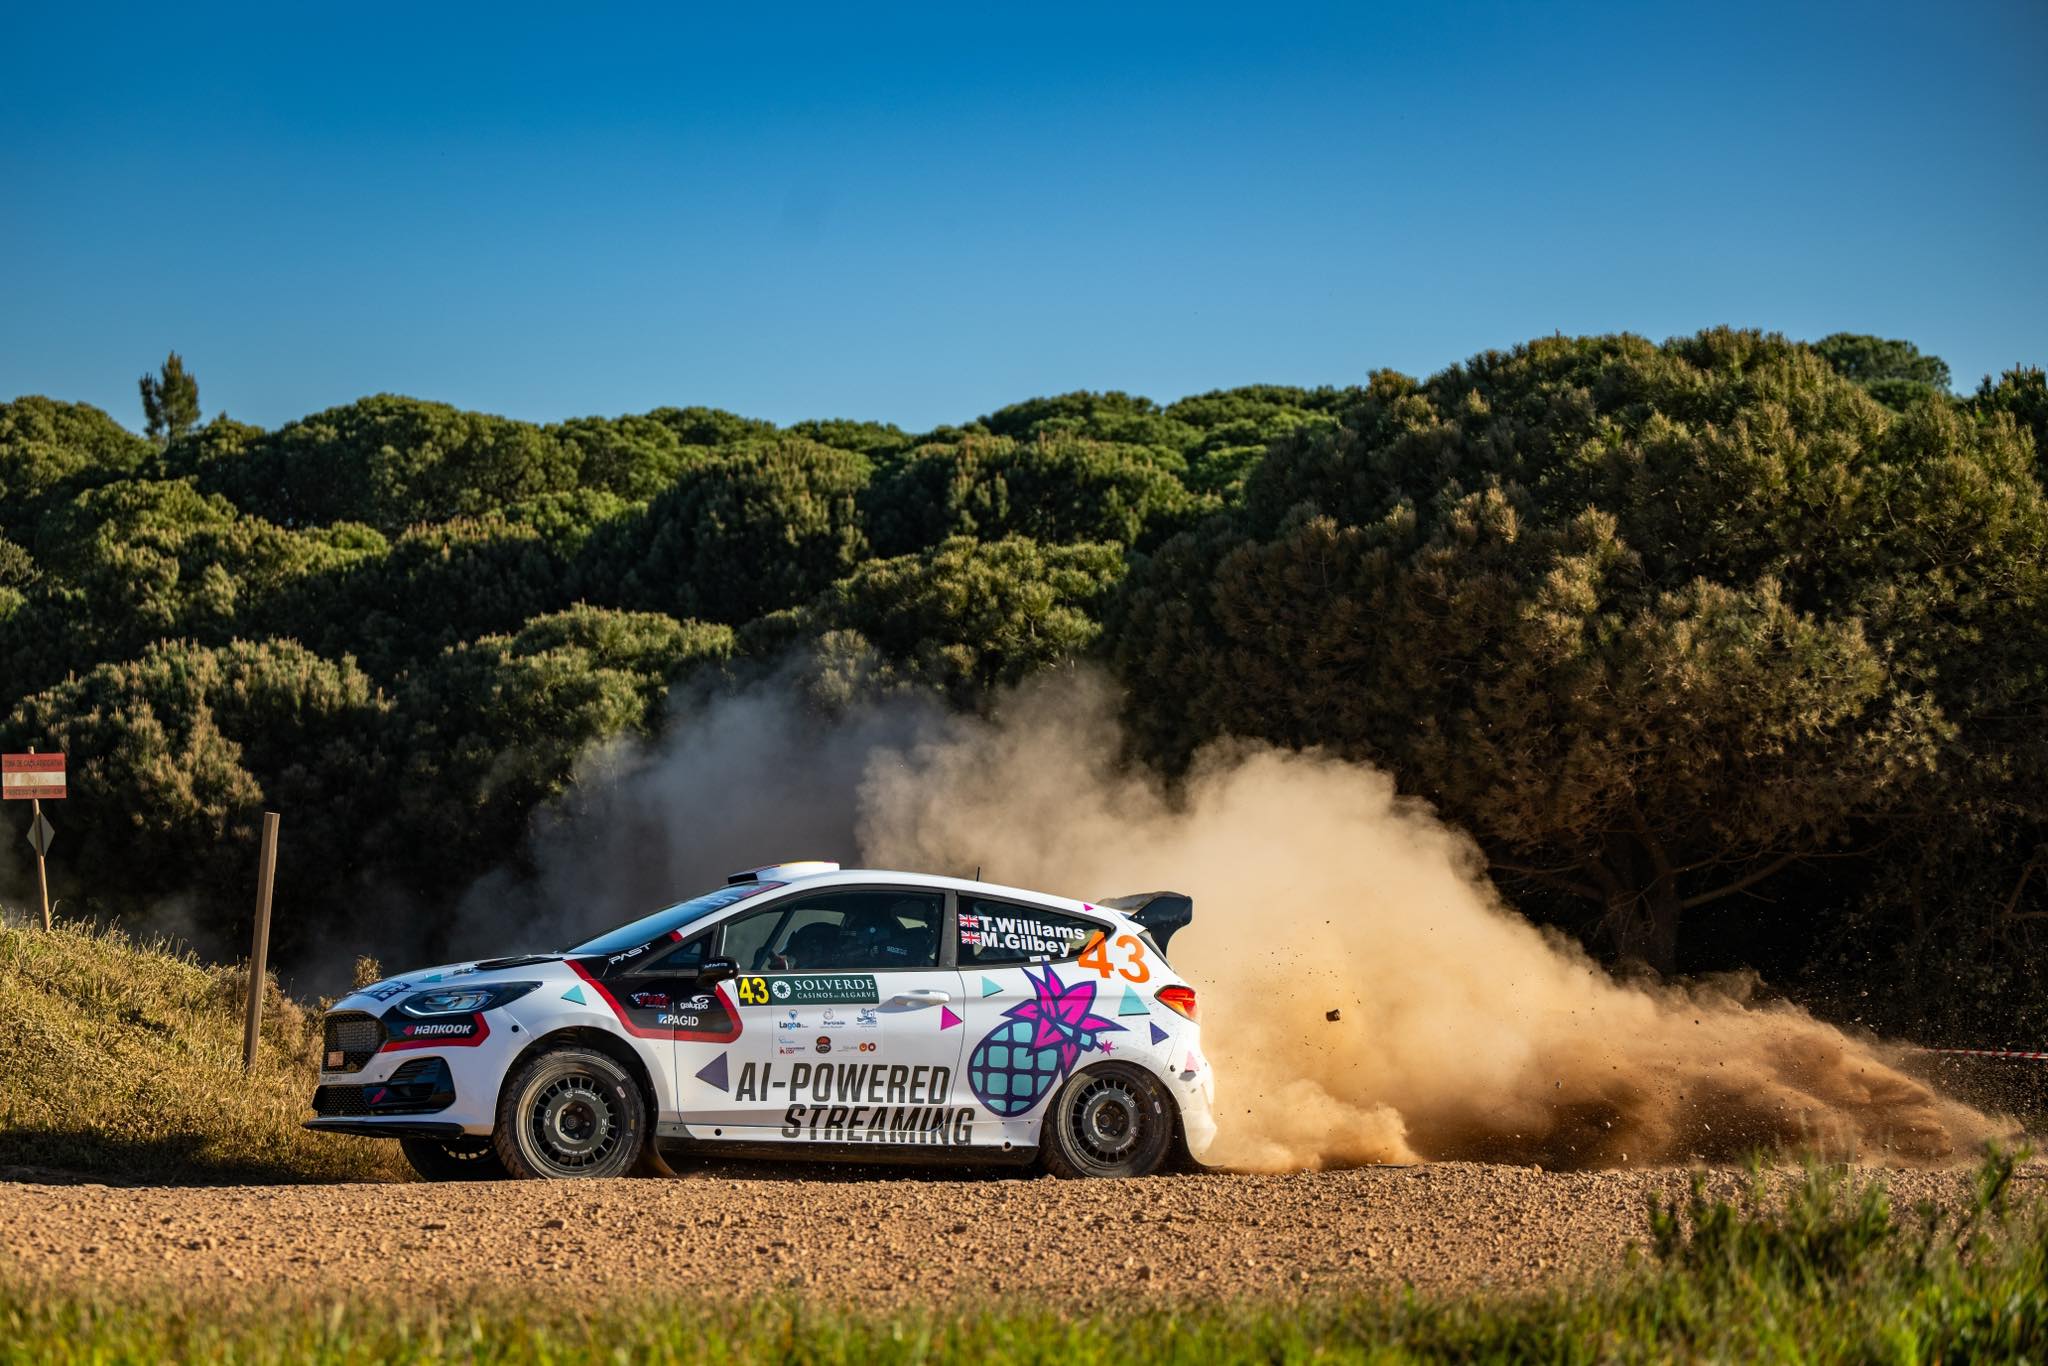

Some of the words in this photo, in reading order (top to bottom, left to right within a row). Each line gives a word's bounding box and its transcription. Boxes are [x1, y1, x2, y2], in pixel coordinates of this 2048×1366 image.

[978, 916, 1086, 940] T.Williams
[980, 932, 1071, 958] M.Gilbey
[1077, 931, 1151, 984] 43
[739, 977, 769, 1005] 43
[794, 979, 875, 991] SOLVERDE
[667, 1014, 699, 1027] PAGID
[779, 1021, 801, 1030] Lagoa
[735, 1062, 951, 1105] AI-POWERED
[781, 1103, 976, 1146] STREAMING
